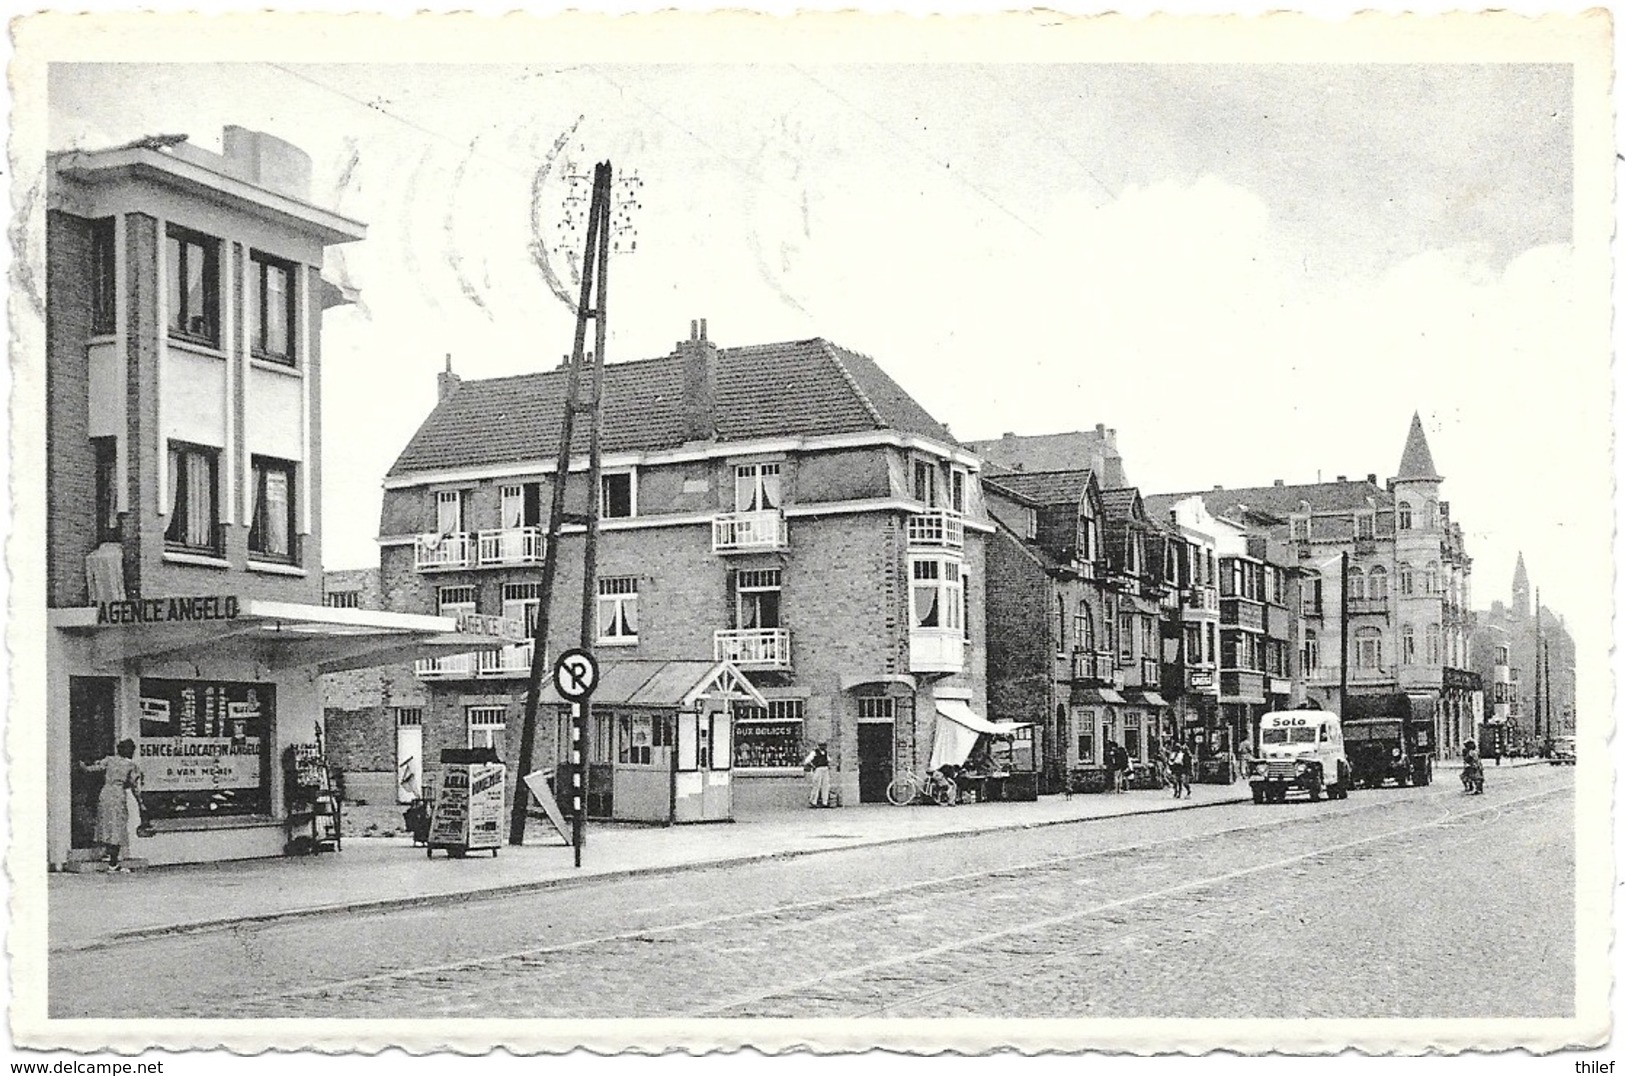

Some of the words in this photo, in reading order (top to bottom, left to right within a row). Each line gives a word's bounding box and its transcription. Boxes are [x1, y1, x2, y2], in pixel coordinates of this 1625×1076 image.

[98, 599, 164, 624] AGENCE
[166, 595, 237, 621] ANGELO
[736, 727, 754, 736] AUX
